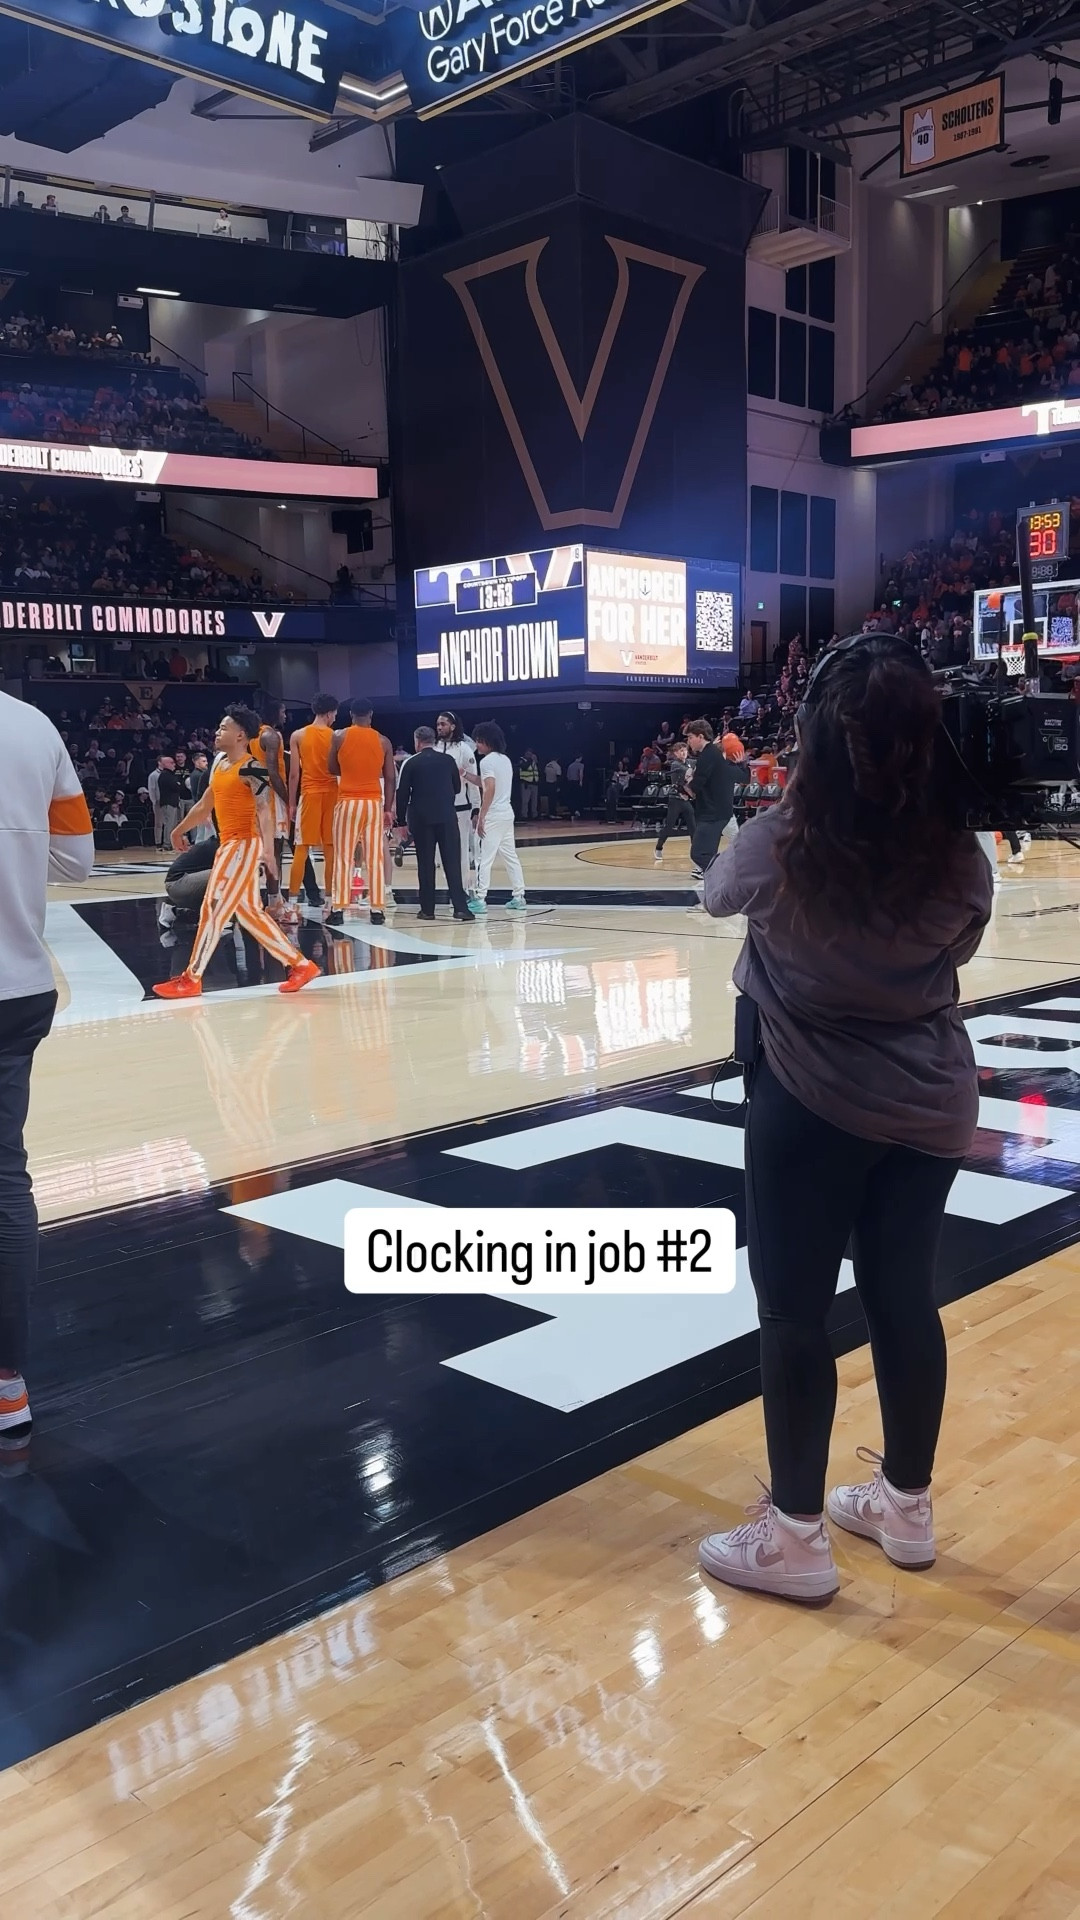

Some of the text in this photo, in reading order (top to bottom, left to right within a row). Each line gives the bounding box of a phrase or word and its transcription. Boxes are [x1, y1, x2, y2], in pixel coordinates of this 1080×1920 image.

[427, 33, 486, 83] Gary
[490, 0, 564, 54] Force
[942, 97, 994, 130] SCHOLTENS
[917, 132, 929, 145] 40
[443, 234, 706, 531] V
[50, 449, 143, 478] COMMODORES
[1030, 512, 1061, 530] 13:53
[1030, 529, 1056, 557] 30
[479, 582, 513, 610] 13:53
[589, 563, 686, 603] ANCHORED
[0, 601, 226, 636] DERBILT COMMODORES
[252, 611, 286, 638] V
[587, 600, 686, 647] FOR HER
[440, 620, 559, 686] ANCHOR DOWN
[750, 769, 757, 778] G
